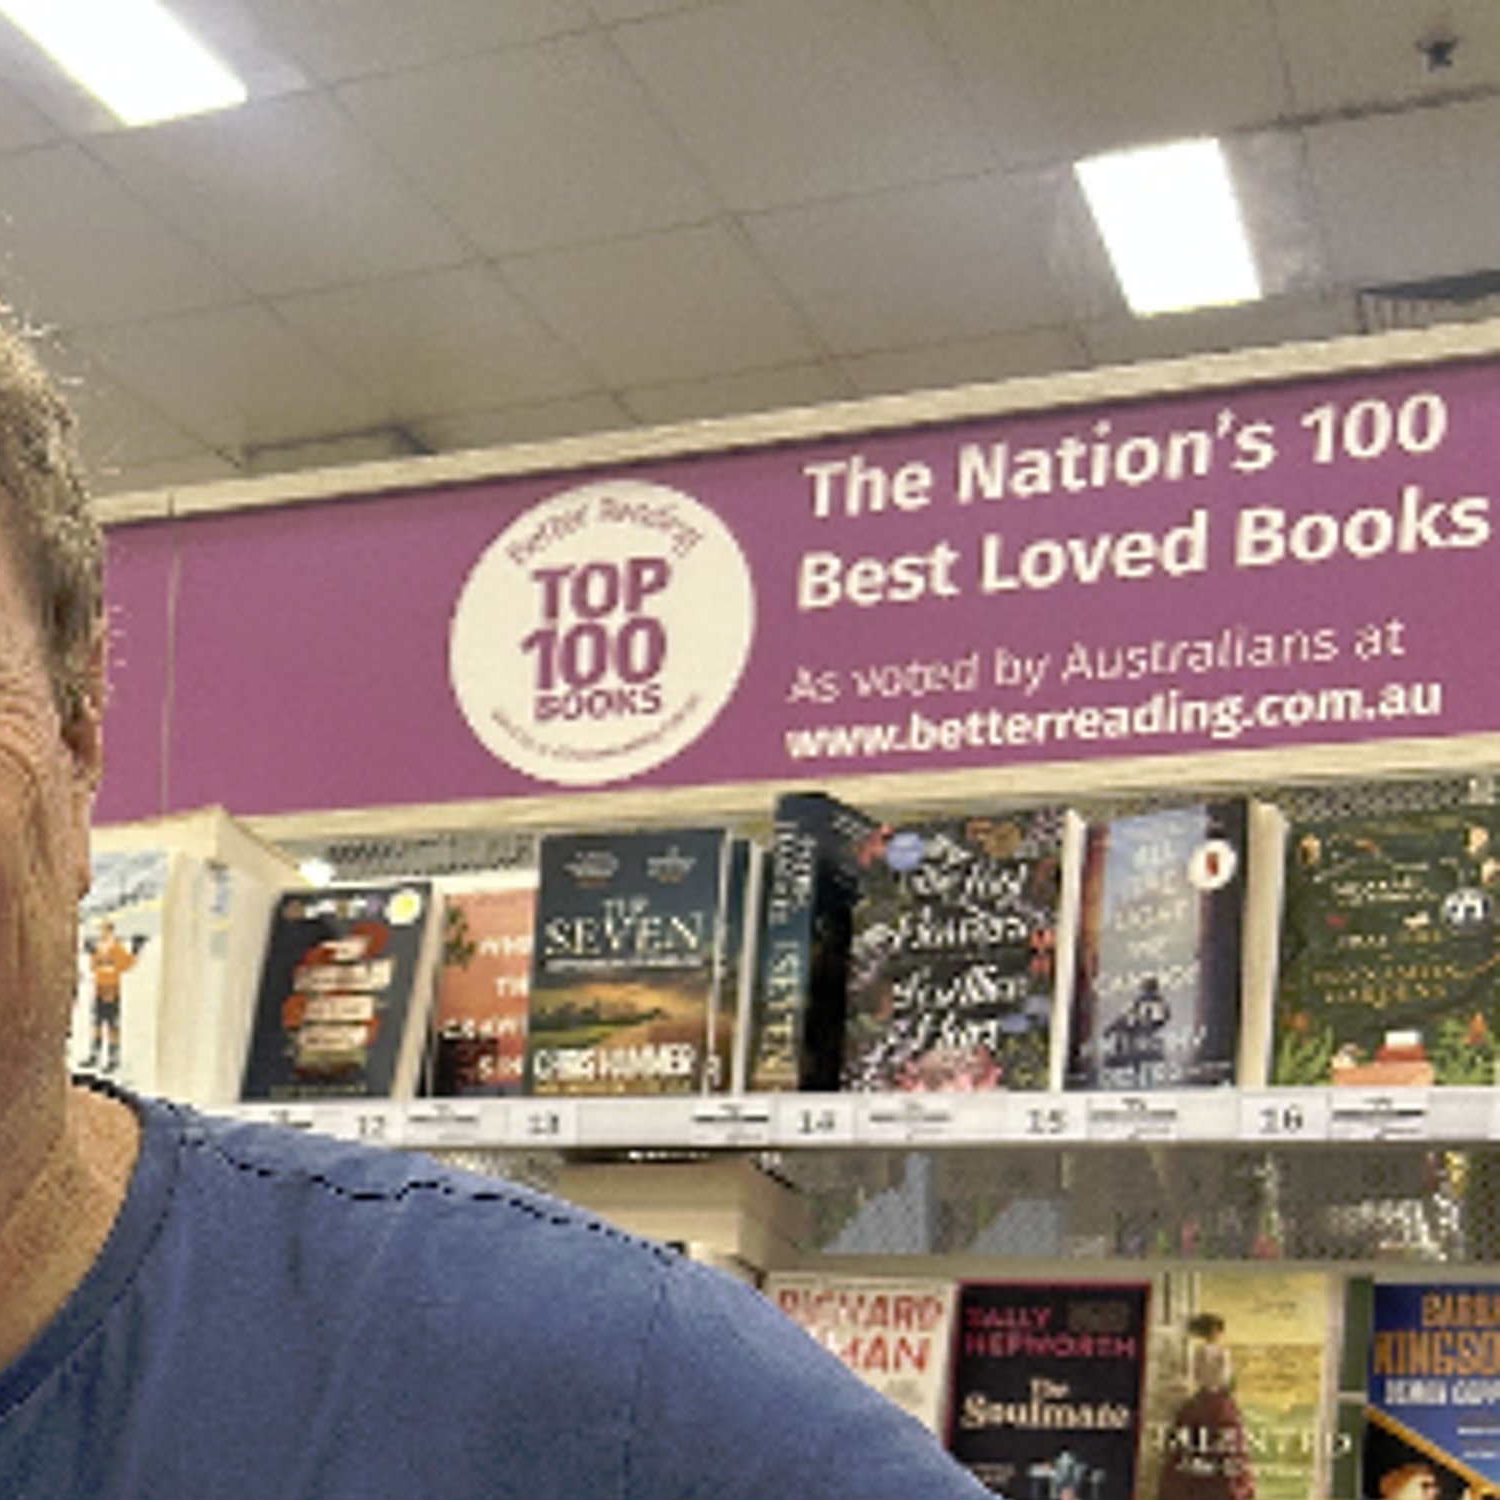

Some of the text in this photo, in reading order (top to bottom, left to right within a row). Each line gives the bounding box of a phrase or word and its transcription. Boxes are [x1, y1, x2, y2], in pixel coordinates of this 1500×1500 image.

[803, 391, 1449, 518] The Nation's 100
[797, 485, 1491, 611] Best Loved Books
[531, 556, 673, 620] TOP
[519, 616, 667, 692] 100
[787, 617, 1406, 703] As voted by Australians at
[533, 682, 663, 722] BOOKS
[783, 681, 1444, 758] www.betterreading.com.au
[544, 911, 706, 956] SEVEN
[1026, 1109, 1069, 1134] 15
[964, 1306, 1054, 1329] SALLY
[964, 1330, 1137, 1358] HEPWORTH
[1373, 1331, 1500, 1375] KINGSO
[1029, 1377, 1071, 1399] The
[959, 1392, 1131, 1430] Soulmate
